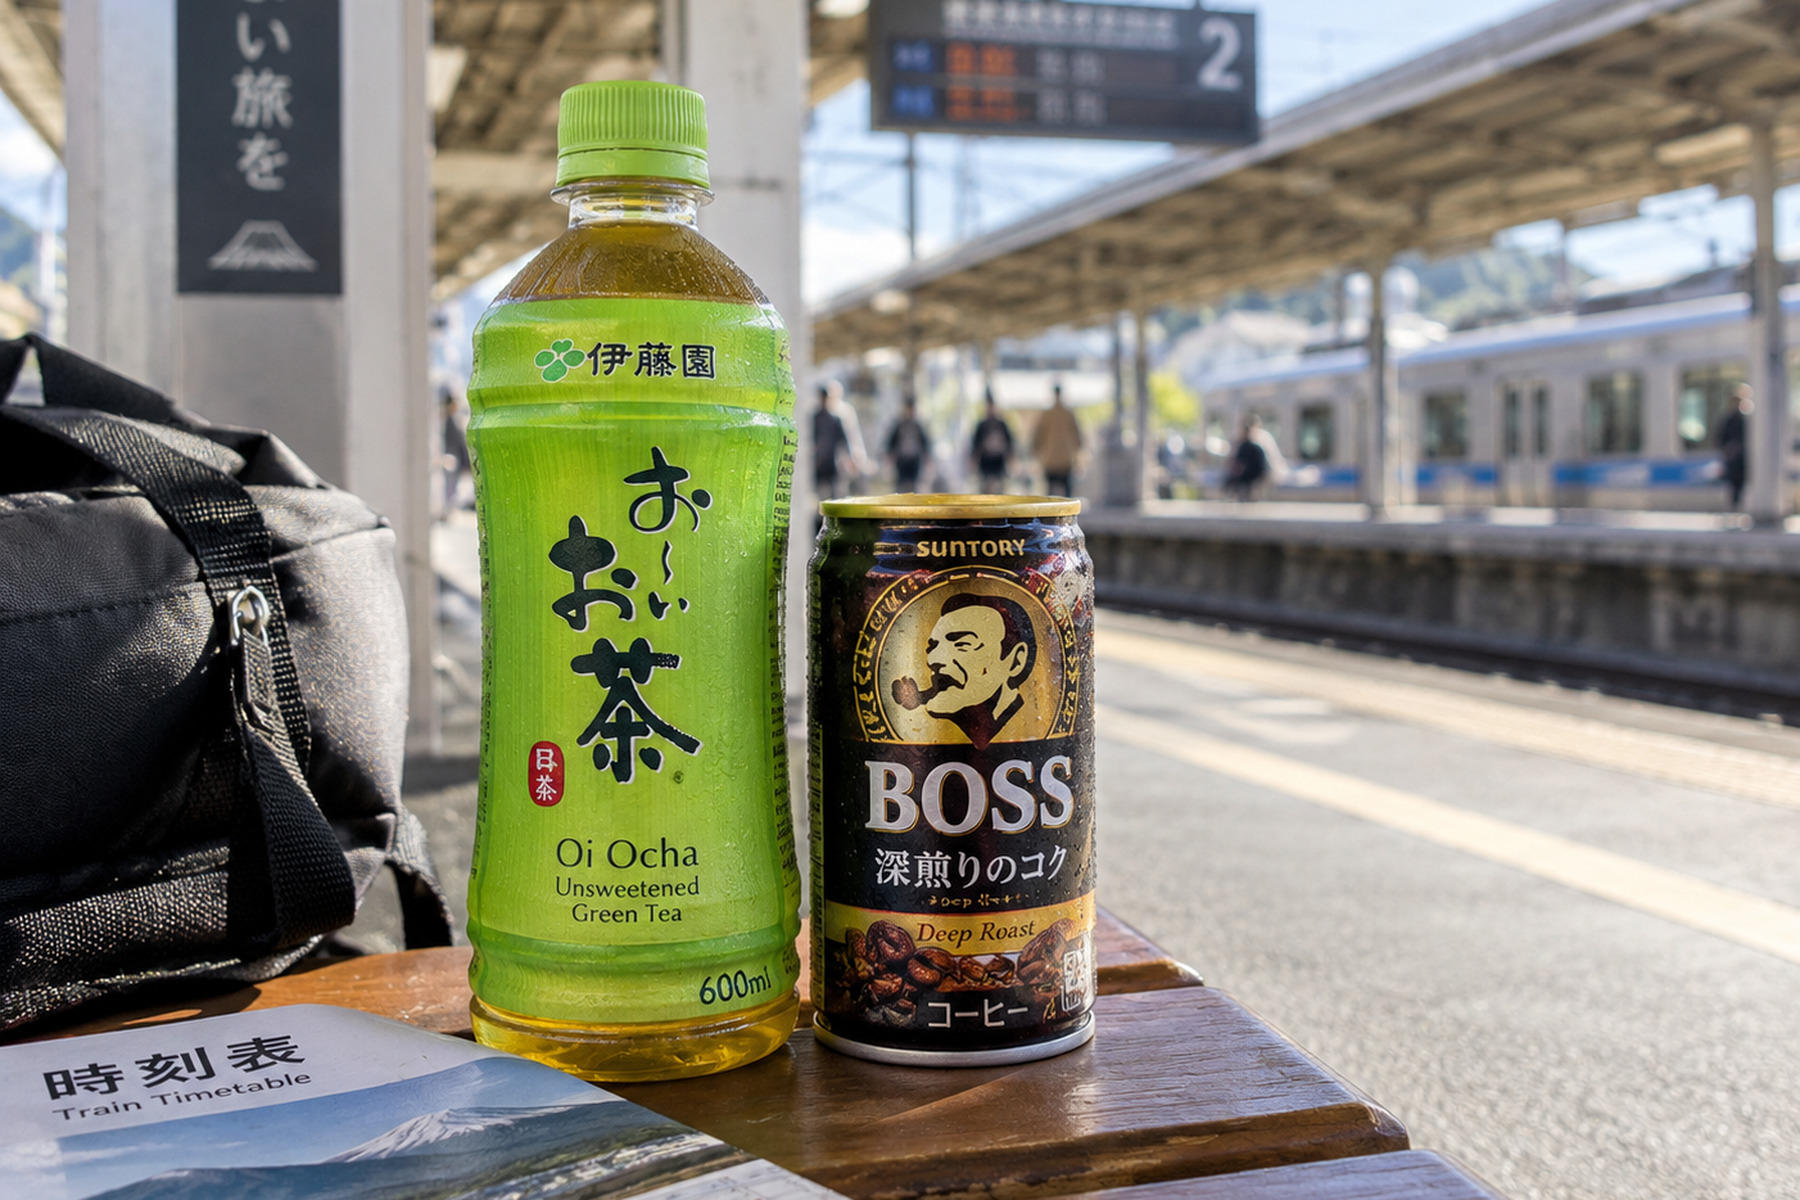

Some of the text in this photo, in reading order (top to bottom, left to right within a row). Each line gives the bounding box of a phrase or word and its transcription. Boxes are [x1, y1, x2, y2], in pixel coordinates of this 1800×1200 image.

[1199, 16, 1243, 91] 2
[231, 0, 294, 191] い旅を
[587, 342, 716, 379] 伊藤園
[916, 538, 1026, 558] SUNTORY
[548, 514, 703, 784] お茶
[865, 755, 1075, 837] BOSS
[556, 837, 700, 869] Oi Ocha
[875, 845, 1068, 889] 深煎りのコク
[555, 876, 700, 898] Unsweetened
[572, 903, 682, 923] Green Tea
[917, 920, 1036, 949] Deep Roast
[699, 966, 772, 1005] 600ml
[928, 999, 1028, 1028] コーヒー
[43, 1034, 305, 1100] 時刻表
[53, 1072, 312, 1120] Train Timetable
